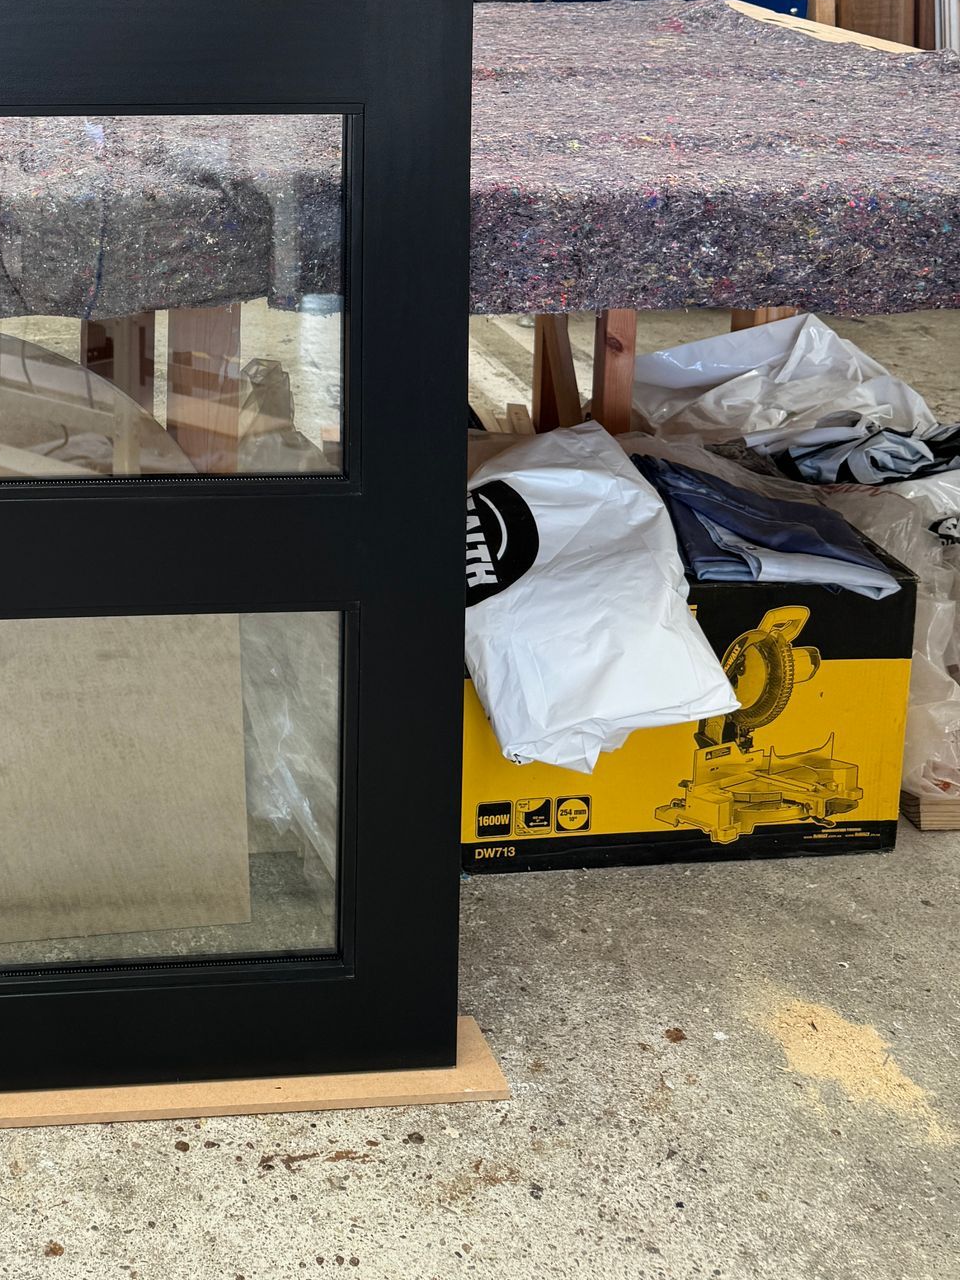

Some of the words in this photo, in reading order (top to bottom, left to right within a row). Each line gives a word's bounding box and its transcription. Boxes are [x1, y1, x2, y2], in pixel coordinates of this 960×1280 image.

[559, 808, 573, 817] 254
[478, 813, 511, 827] 1600W
[474, 846, 516, 859] DW713
